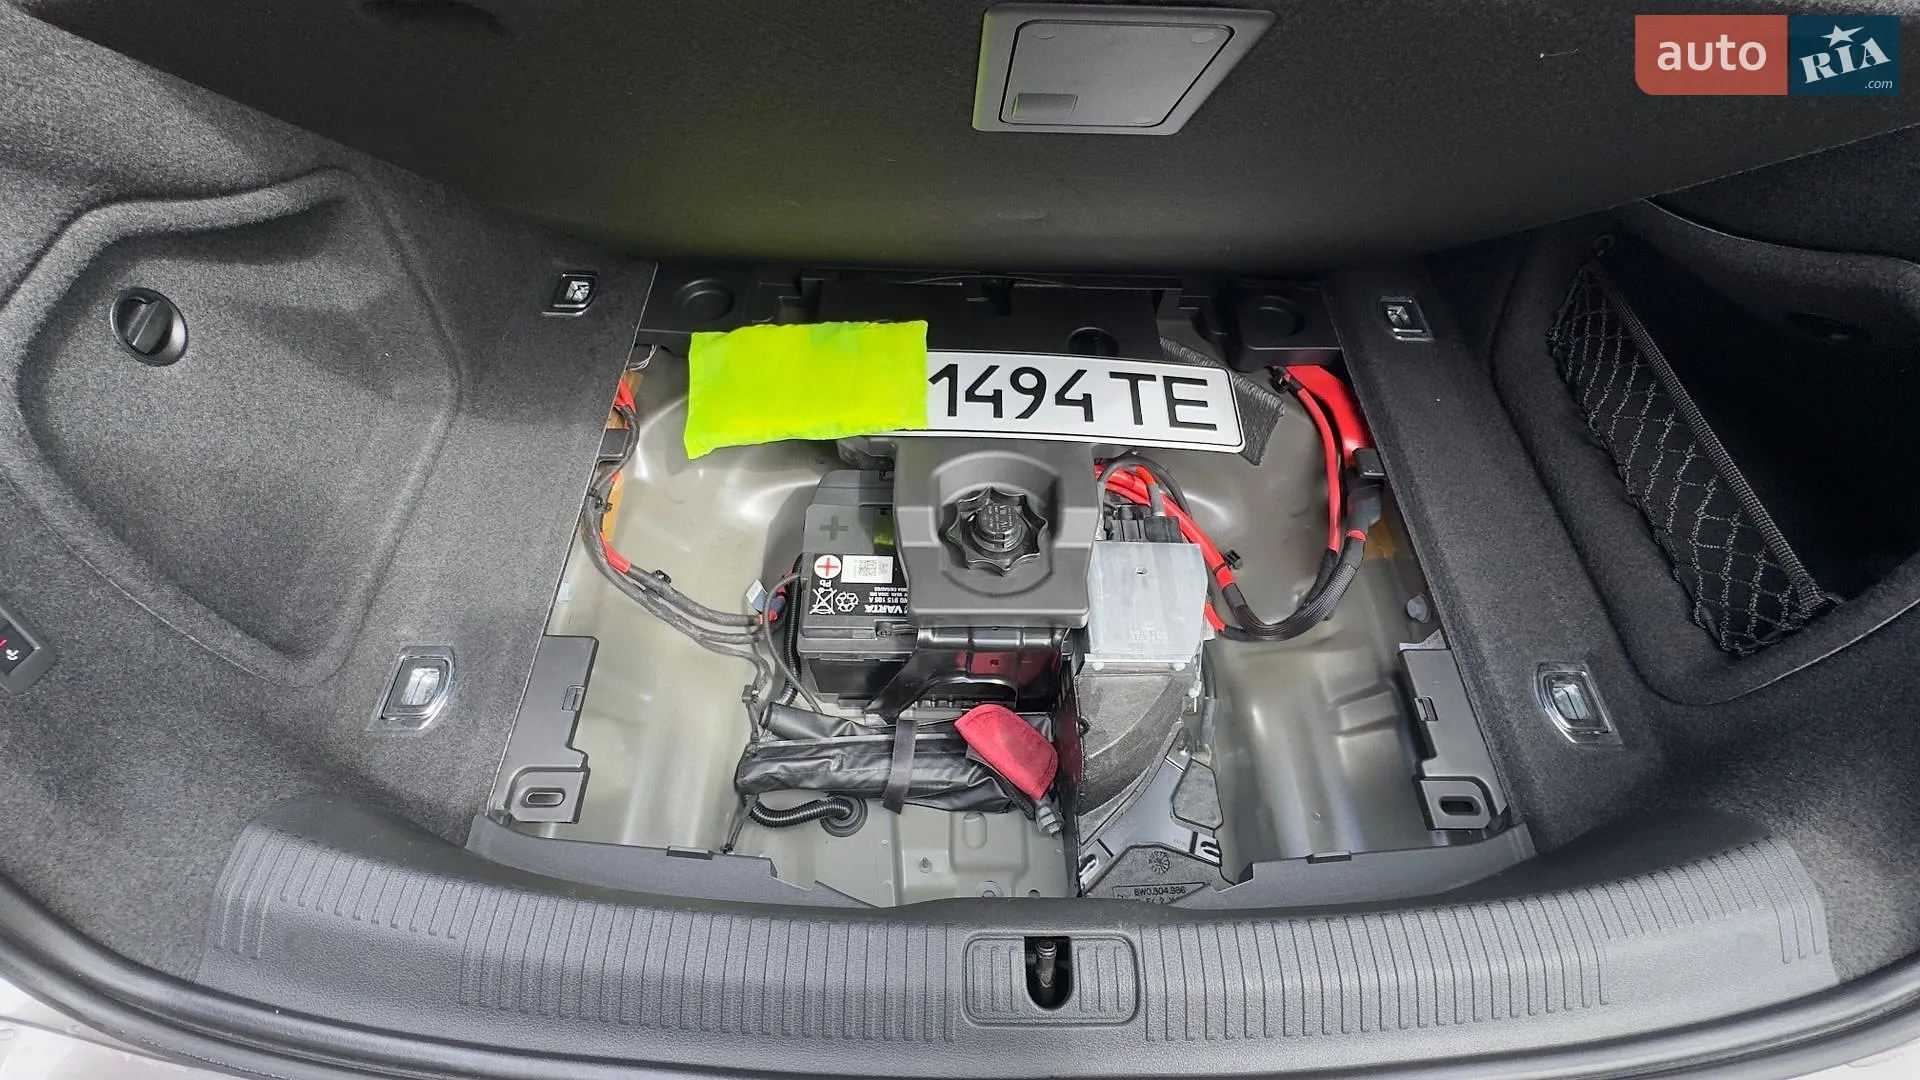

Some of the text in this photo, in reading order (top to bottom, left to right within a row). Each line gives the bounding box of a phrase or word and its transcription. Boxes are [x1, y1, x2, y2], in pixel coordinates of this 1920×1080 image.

[928, 363, 1218, 431] 1494 TE
[819, 580, 832, 588] Pb
[864, 604, 903, 614] VARTA
